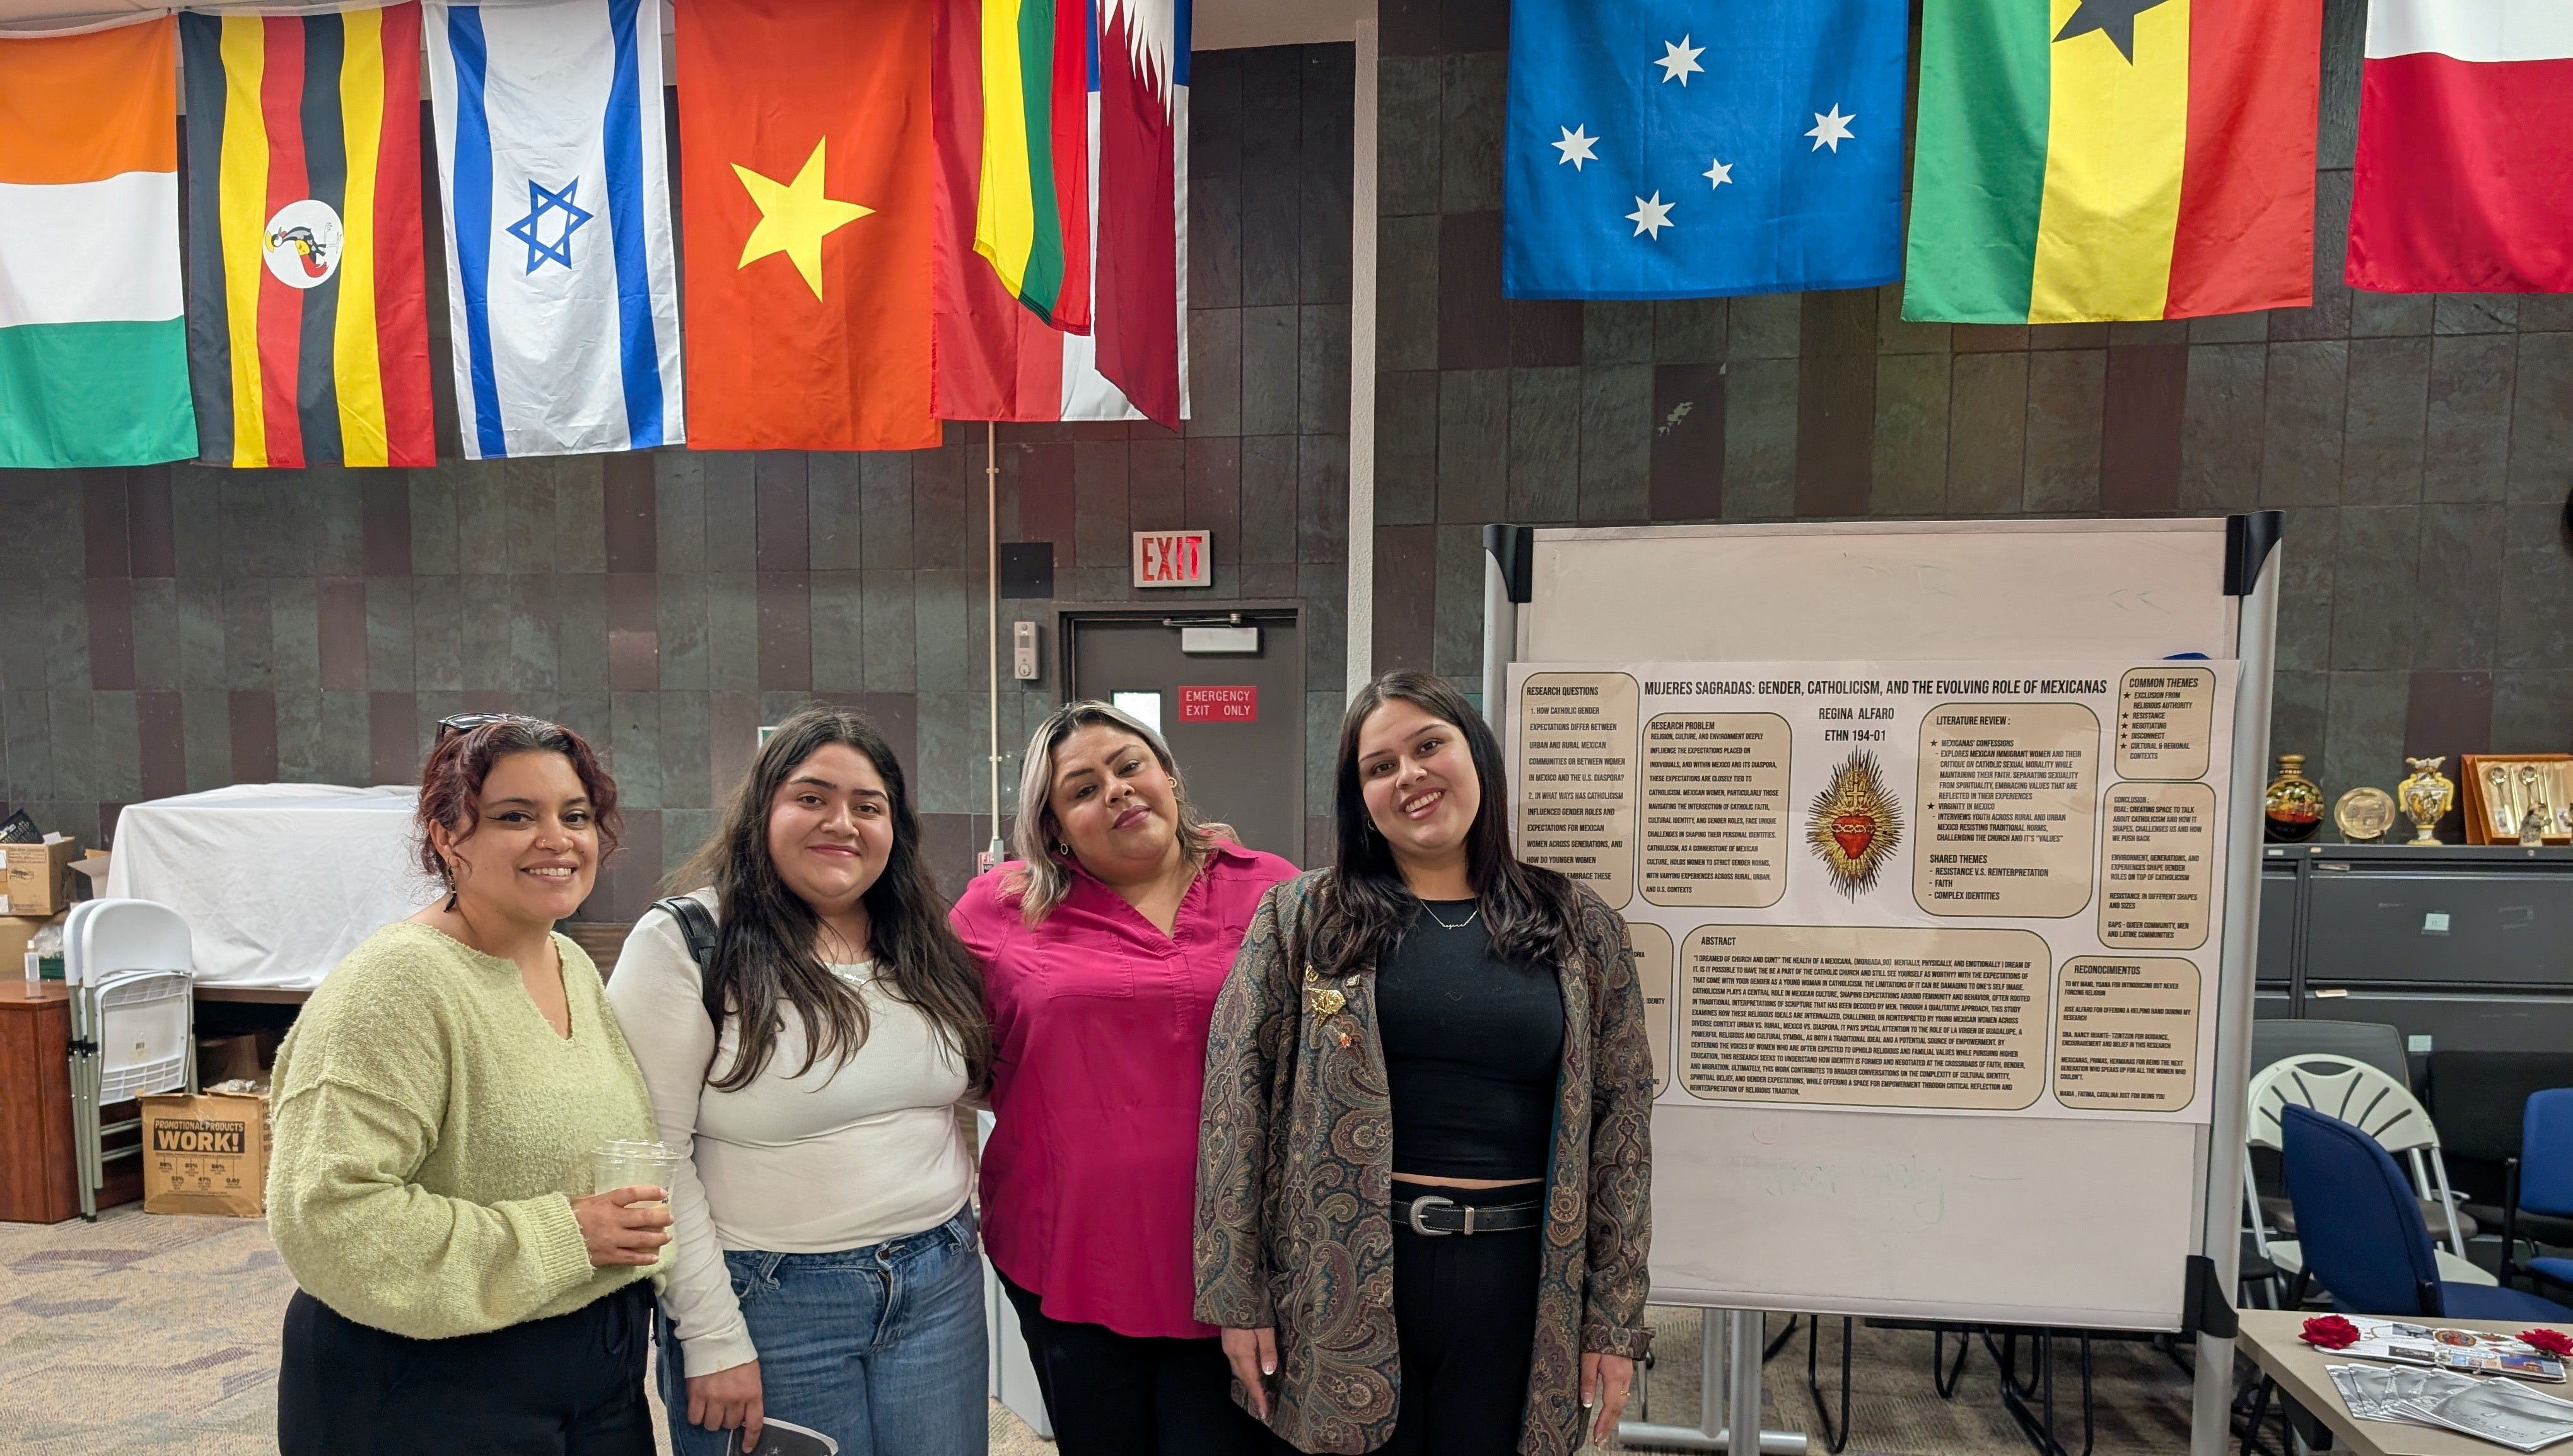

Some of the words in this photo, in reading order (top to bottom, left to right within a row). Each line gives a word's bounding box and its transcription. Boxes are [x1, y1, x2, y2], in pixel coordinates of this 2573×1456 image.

[1142, 536, 1202, 581] EXIT
[2130, 678, 2164, 687] COMMON
[2167, 678, 2198, 687] THEMES
[1645, 682, 1693, 694] MUJERES
[1696, 682, 1755, 695] SAGRADAS:
[1758, 681, 1804, 695] GENDER,
[1807, 681, 1882, 696] CATHOLICISM,
[1886, 680, 1909, 694] AND
[1913, 680, 1933, 694] THE
[1937, 680, 1988, 694] EVOLVING
[1992, 680, 2020, 694] ROLE
[2024, 680, 2038, 694] OF
[2041, 680, 2107, 694] MEXICANAS
[1186, 691, 1250, 701] EMERGENCY
[1186, 706, 1210, 716] EXIT
[1224, 706, 1250, 716] ONLY
[1819, 708, 1853, 719] REGINA
[1858, 708, 1894, 719] ALFARO
[1937, 716, 1978, 725] LITERATURE
[1980, 716, 2007, 725] REVIEW
[1825, 730, 1848, 741] ETHN
[1853, 730, 1886, 741] 194-01
[1930, 855, 1957, 863] SHARED
[1960, 855, 1987, 863] THEMES
[1988, 868, 2048, 877] REINTERPRETATION
[1701, 937, 1736, 945] ABSTRACT
[2075, 965, 2140, 975] RECONOCIMIENTOS
[155, 1120, 204, 1131] PROMOTIONAL
[206, 1121, 243, 1131] PRODUCTS
[158, 1131, 238, 1151] WORK!
